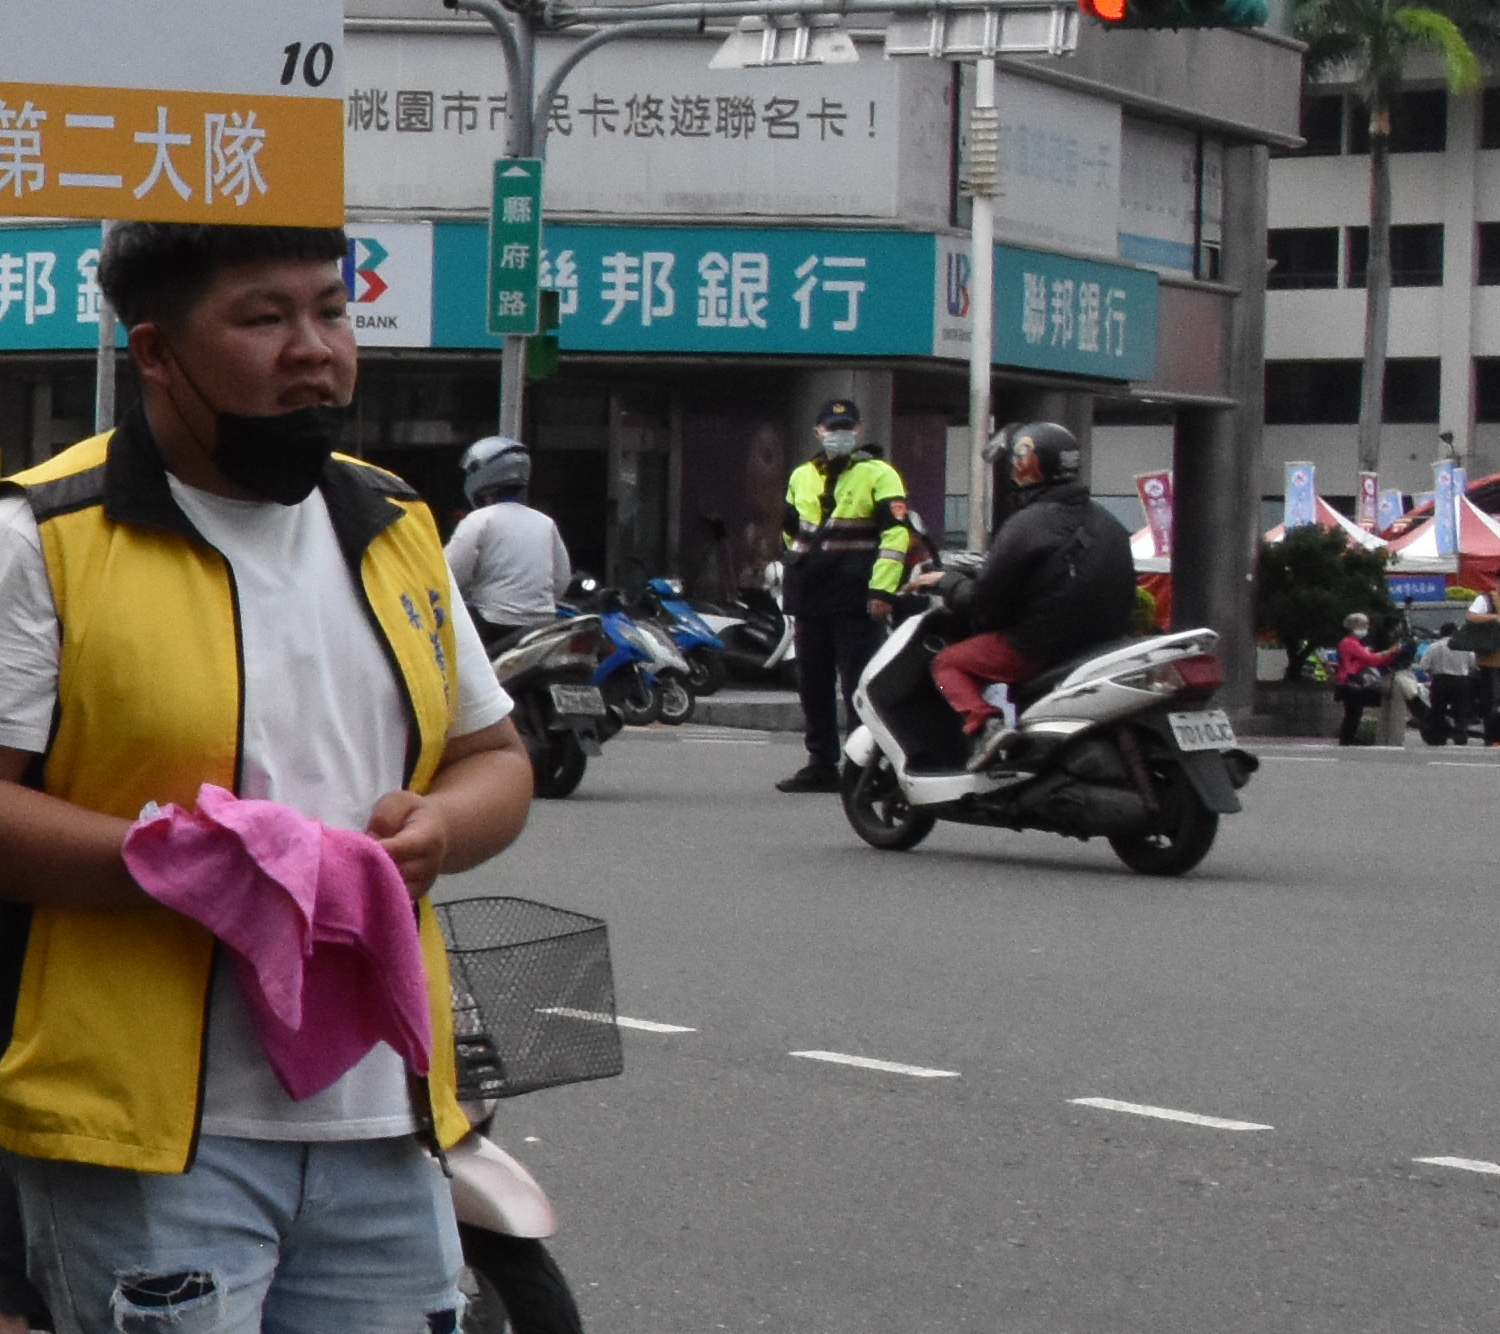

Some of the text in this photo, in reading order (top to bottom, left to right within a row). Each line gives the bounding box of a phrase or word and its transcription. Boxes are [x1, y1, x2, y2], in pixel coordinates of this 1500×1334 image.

[279, 41, 334, 88] 10
[497, 195, 533, 318] 縣府路
[355, 315, 399, 330] BANK
[1021, 271, 1127, 357] 聯邦銀行
